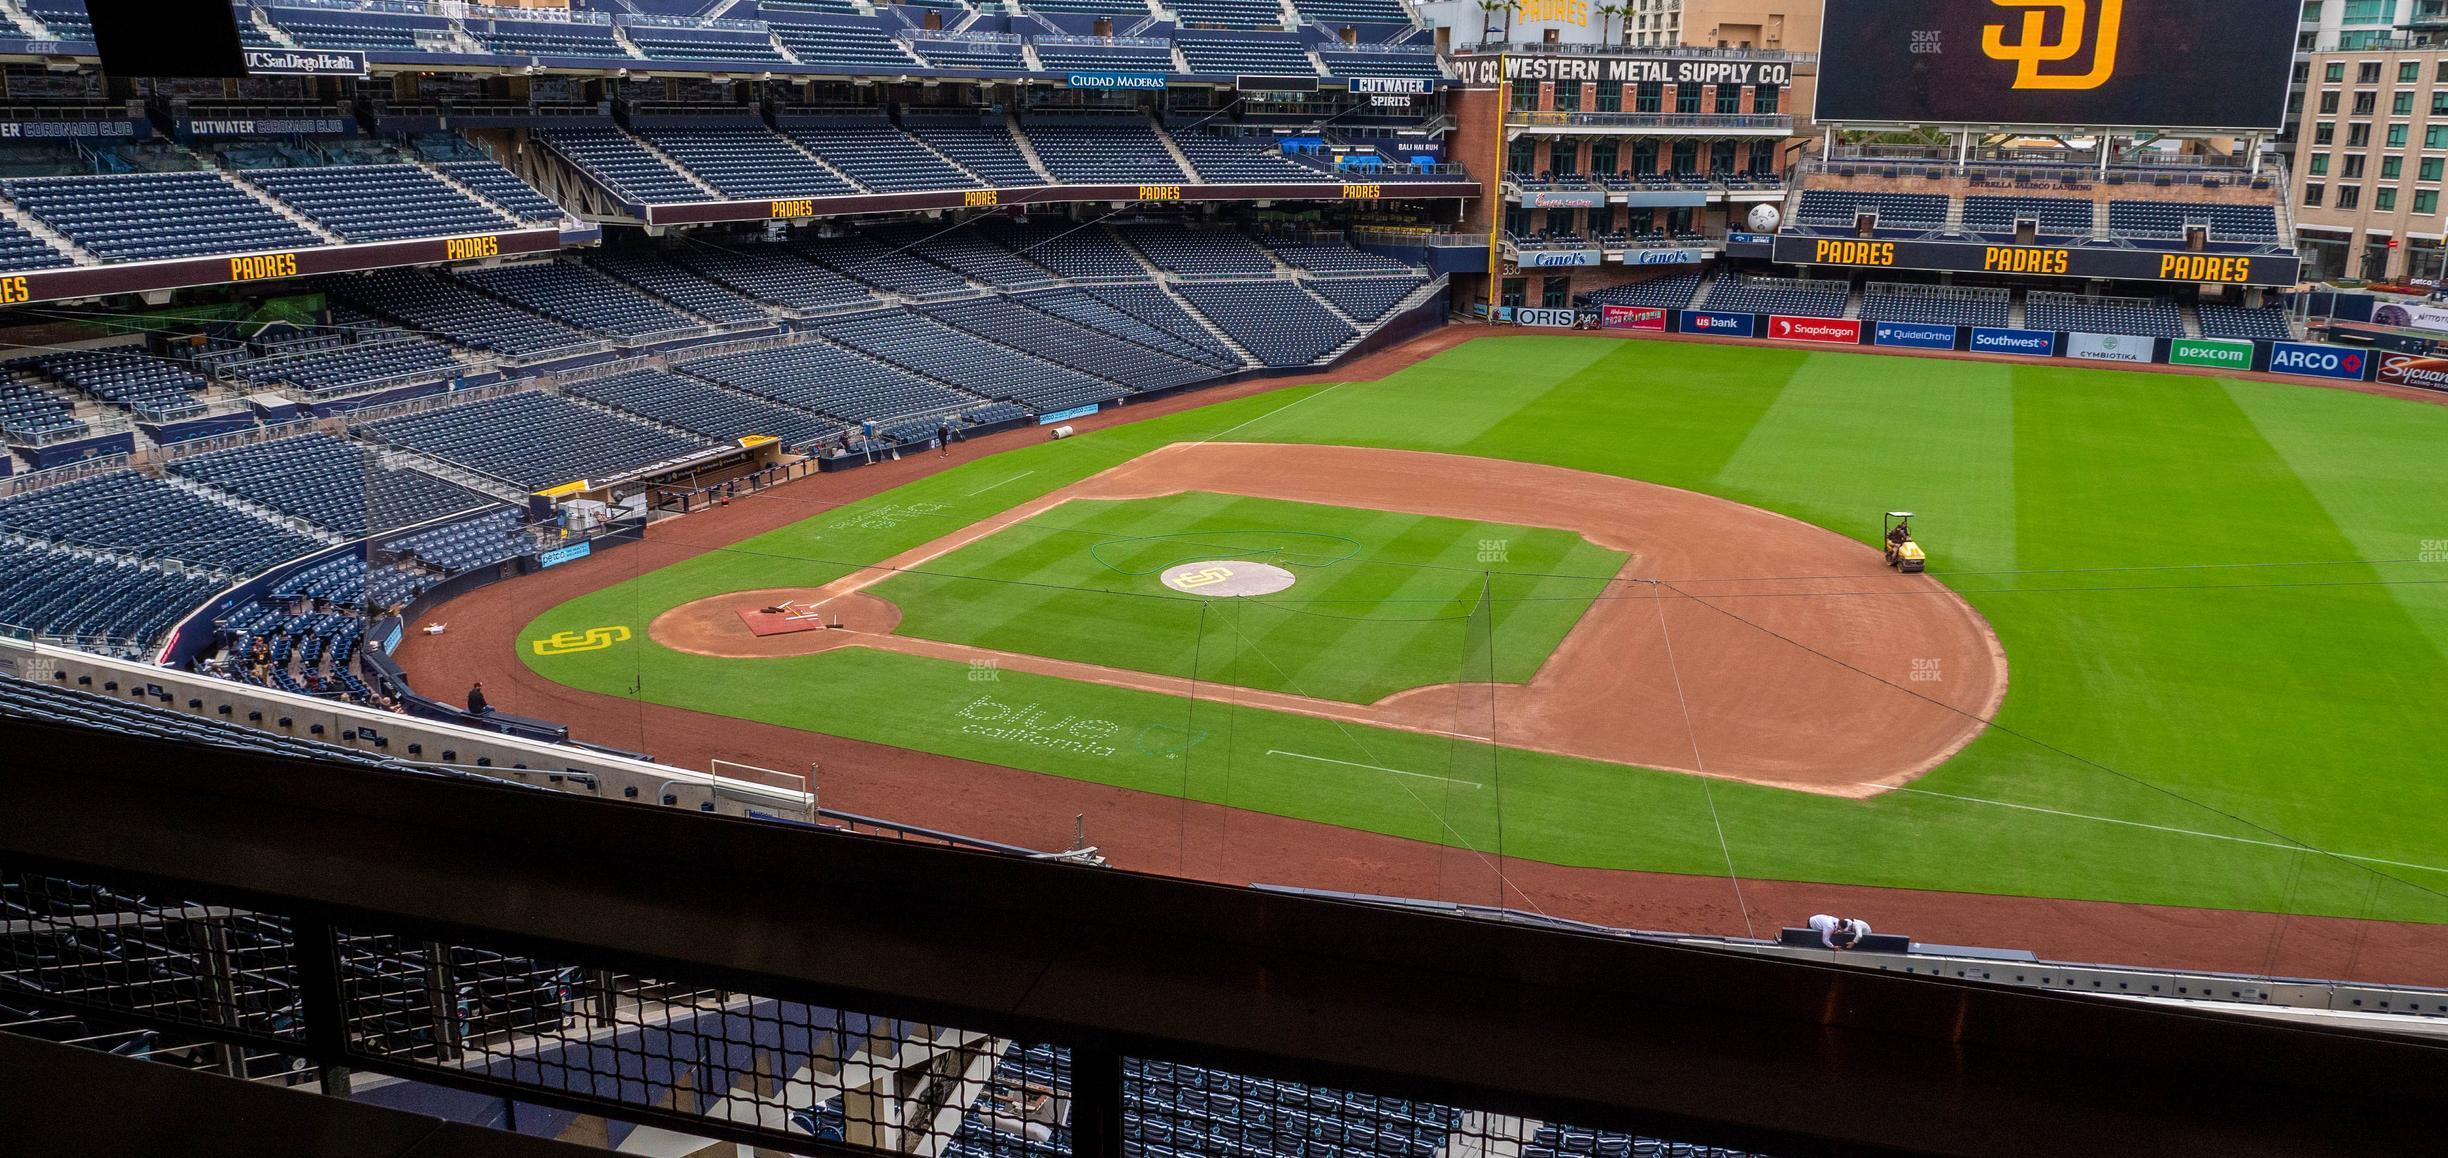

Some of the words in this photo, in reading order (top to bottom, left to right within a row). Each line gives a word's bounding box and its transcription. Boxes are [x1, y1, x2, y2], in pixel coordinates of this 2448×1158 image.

[1518, 0, 1588, 28] PADRES
[286, 54, 318, 72] Diego
[318, 55, 355, 70] Health
[1504, 57, 1600, 80] WESTERN
[1609, 60, 1673, 82] METAL
[1678, 62, 1752, 84] SUPPLY
[1758, 64, 1789, 84] CO.
[1071, 75, 1114, 87] CIUDAD
[1116, 76, 1164, 88] MADERAS
[1359, 79, 1424, 93] CUTWATER
[1371, 96, 1411, 107] SPIRITS
[24, 122, 98, 137] CORONADO
[100, 121, 134, 136] CLUB
[191, 120, 254, 134] CUTWATER
[257, 119, 315, 133] CORONADO
[317, 119, 344, 132] CLUB
[1398, 143, 1413, 151] BALI
[1139, 186, 1180, 200] PADRES
[1343, 185, 1380, 199] PADRES
[1969, 181, 2012, 189] ESTRELLA
[2015, 182, 2050, 190] JALISCO
[2052, 183, 2092, 191] LANDING
[964, 191, 997, 206] PADRES
[771, 200, 813, 218] PADRES
[446, 236, 498, 260] PADRES
[1815, 240, 1894, 266] PADRES
[1534, 252, 1586, 267] Canel's
[1639, 250, 1688, 265] Canel's
[1984, 247, 2069, 274] PADRES
[231, 253, 297, 281] PADRES
[2159, 254, 2250, 282] PADRES
[2410, 278, 2432, 286] petco
[1519, 309, 1572, 326] ORIS
[1696, 316, 1710, 327] us
[1711, 317, 1738, 328] bank
[1794, 323, 1854, 338] Snapdragon
[1893, 329, 1951, 342] QuidelOrtho
[1976, 334, 2039, 348] Southwest
[2080, 350, 2137, 361] CYMBIOTIKA
[2273, 350, 2339, 371] ARCO
[955, 695, 1118, 739] blue
[962, 724, 1116, 757] california
